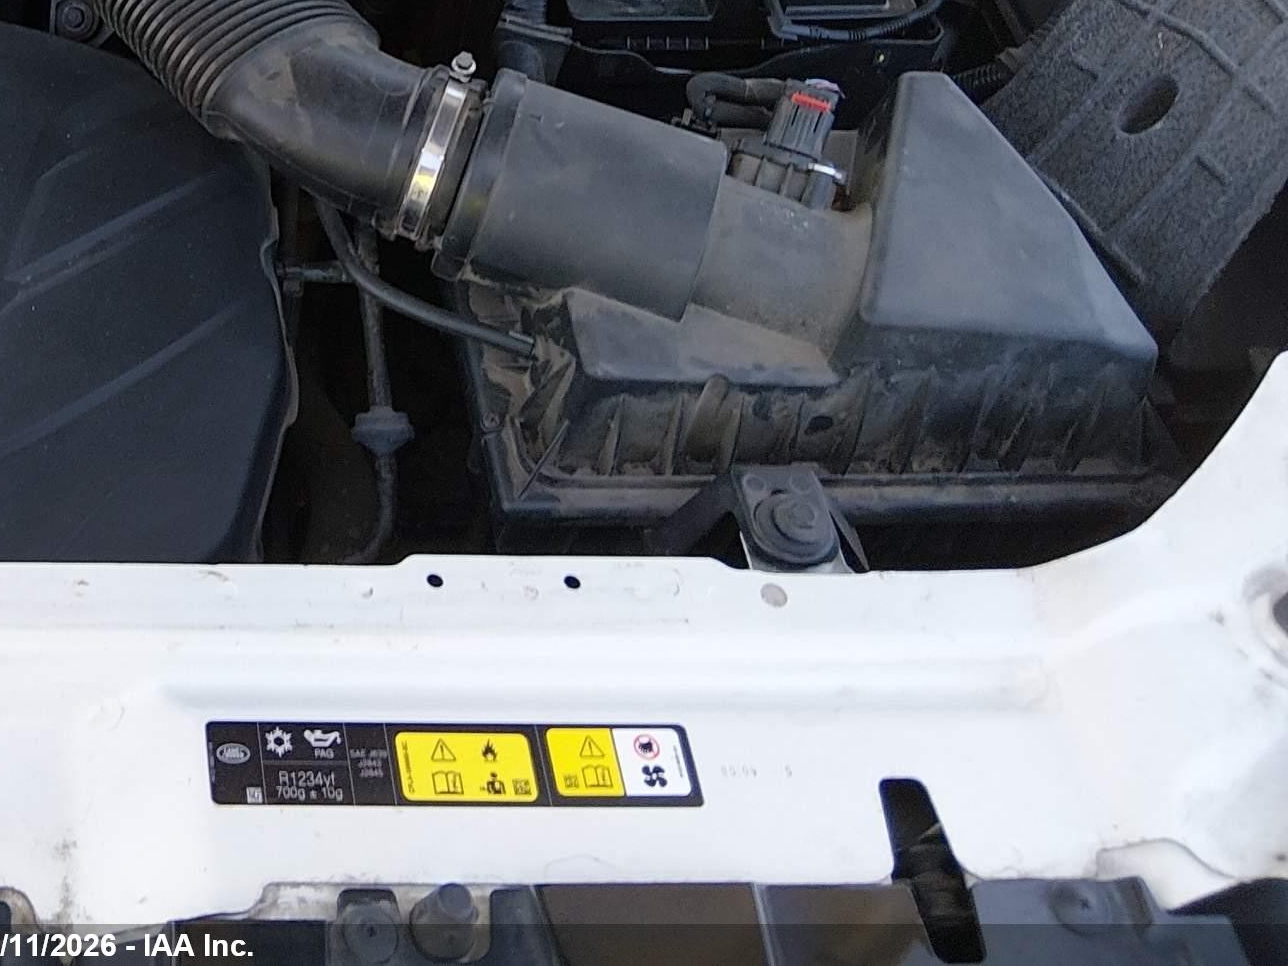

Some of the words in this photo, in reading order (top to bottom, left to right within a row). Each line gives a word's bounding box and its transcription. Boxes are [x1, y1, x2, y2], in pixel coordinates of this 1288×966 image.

[314, 748, 334, 760] PAG
[276, 785, 306, 801] 700g
[321, 785, 344, 802] 10g
